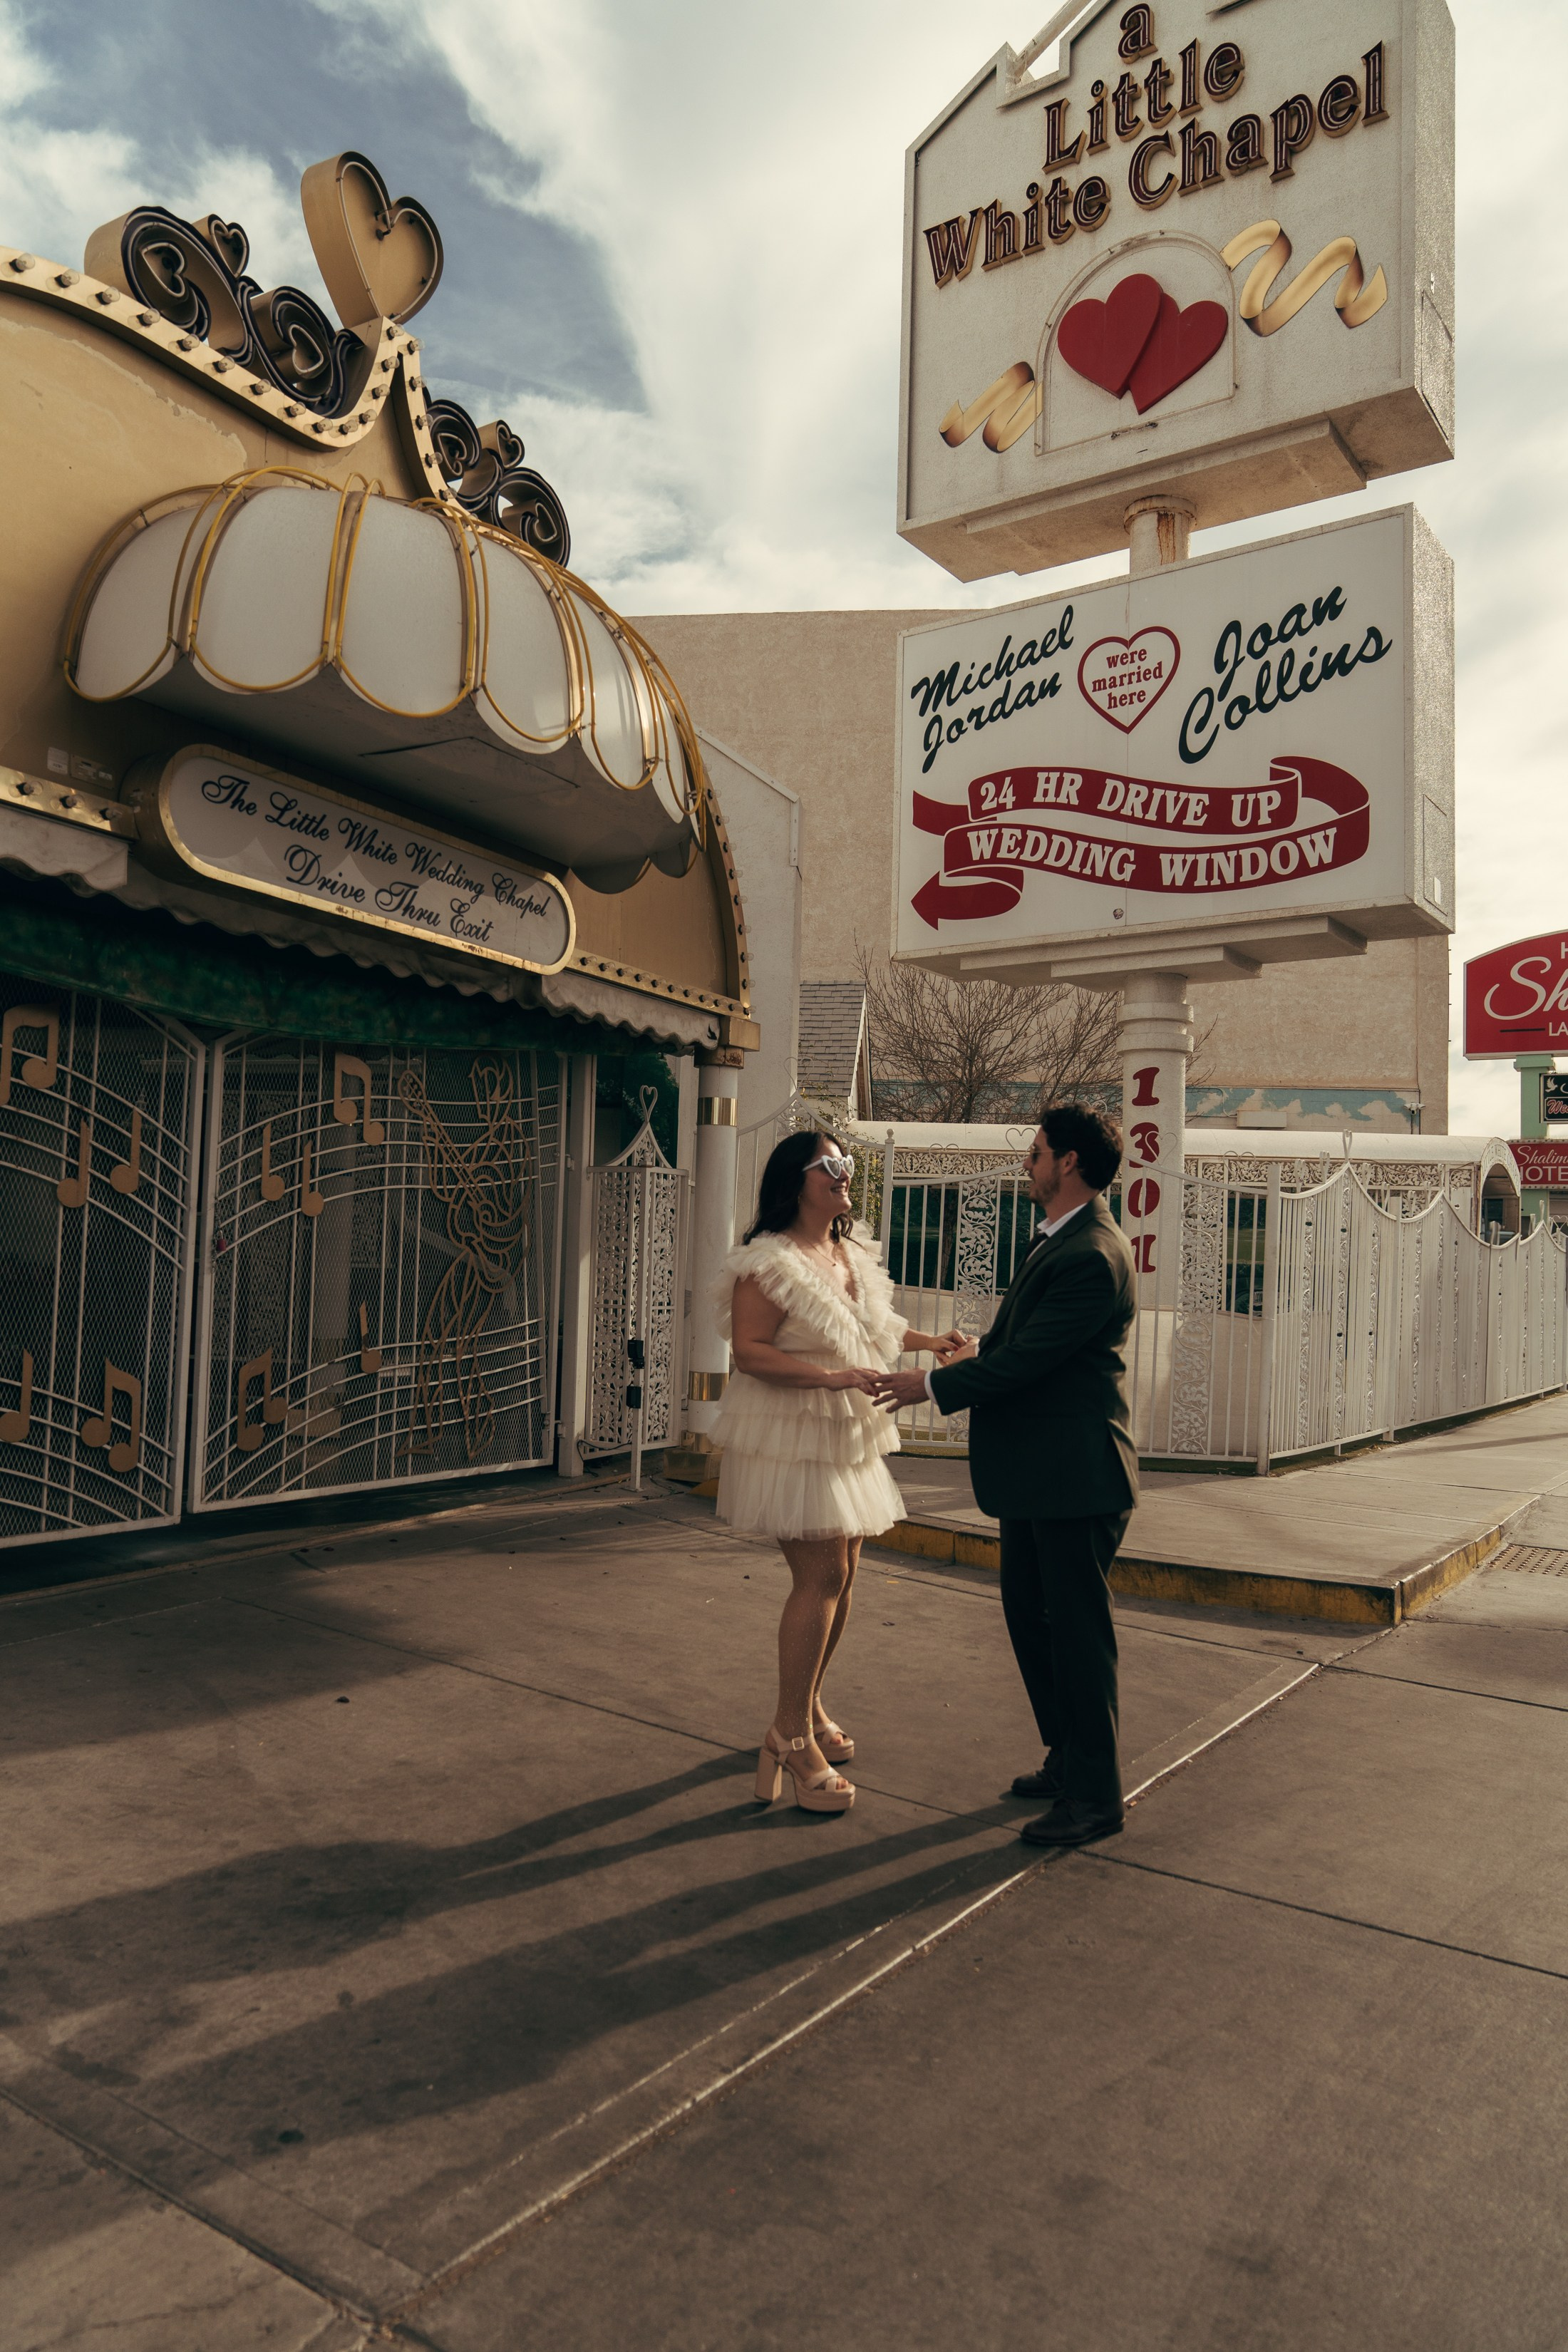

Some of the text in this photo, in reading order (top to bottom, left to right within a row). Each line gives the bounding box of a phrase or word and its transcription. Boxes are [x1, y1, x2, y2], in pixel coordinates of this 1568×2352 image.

[1118, 3, 1157, 63] a
[1042, 38, 1244, 174] Little
[923, 41, 1389, 288] White Chapel
[911, 605, 1073, 717] Michael
[1092, 662, 1162, 693] married
[1106, 648, 1147, 669] were
[1178, 625, 1393, 764] Collins
[1214, 586, 1347, 703] Joan
[922, 671, 1062, 774] Jordan
[1107, 688, 1147, 709] here
[201, 775, 550, 919] The Little White Wedding Chapel
[979, 772, 1282, 827] 24 HR DRIVE UP
[284, 845, 495, 942] Drive Thru Exit
[966, 827, 1338, 888] WEDDING WINDOW
[1128, 1066, 1160, 1274] 1301
